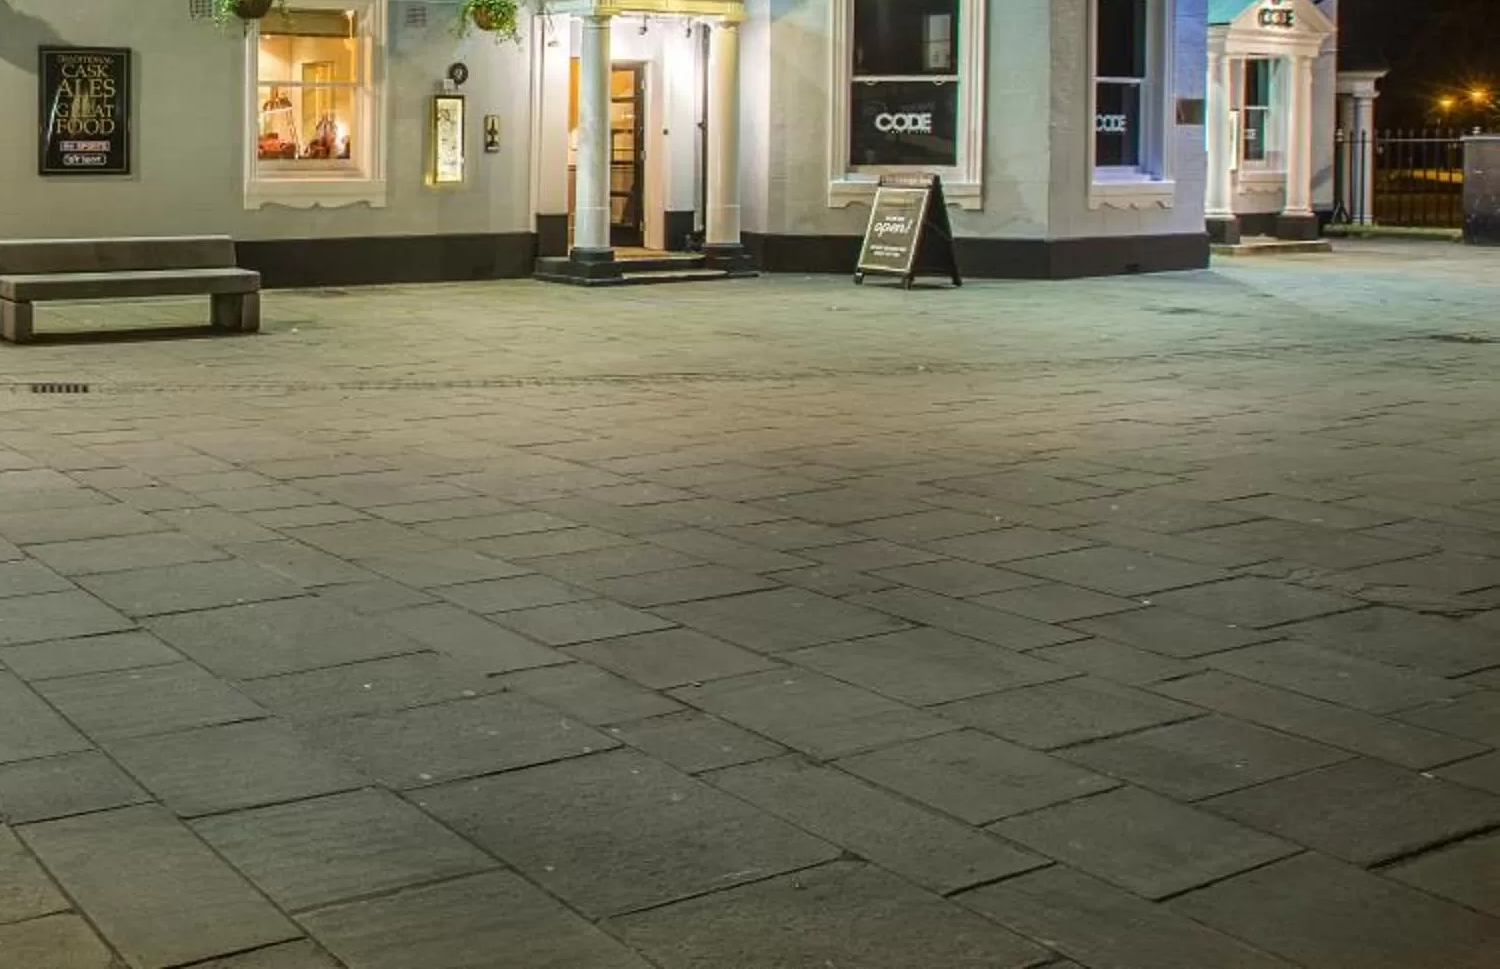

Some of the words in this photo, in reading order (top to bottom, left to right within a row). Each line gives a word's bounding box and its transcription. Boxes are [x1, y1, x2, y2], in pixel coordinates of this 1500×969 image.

[61, 63, 110, 78] CASK
[57, 78, 117, 98] ALES
[54, 102, 115, 119] GEAT
[56, 118, 115, 136] FOOD
[875, 112, 933, 131] CODE
